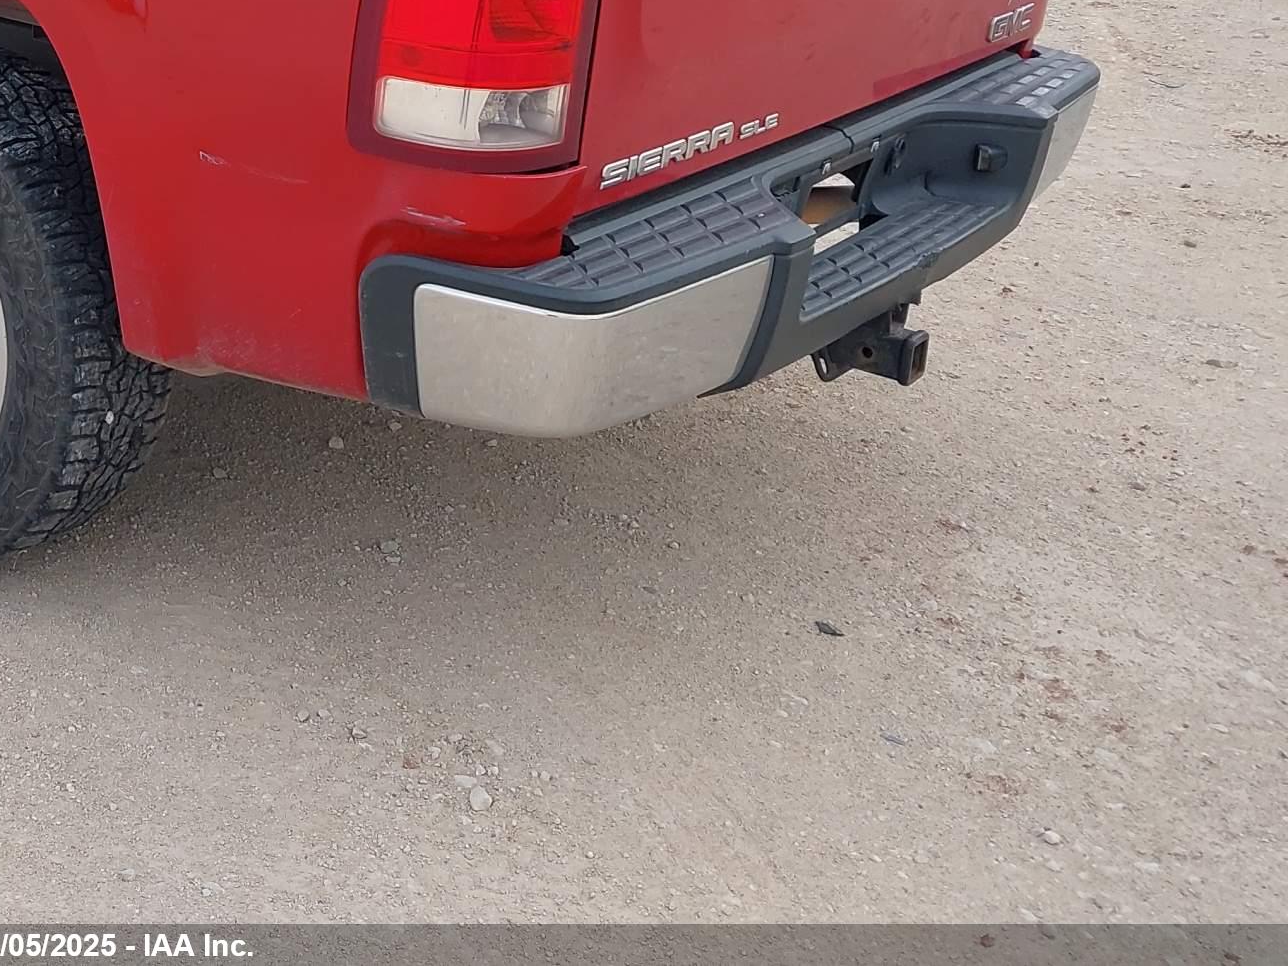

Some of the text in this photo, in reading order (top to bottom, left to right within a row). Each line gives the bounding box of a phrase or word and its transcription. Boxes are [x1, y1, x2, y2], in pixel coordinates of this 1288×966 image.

[989, 2, 1035, 43] GMC
[600, 112, 779, 190] SIERRA SLE
